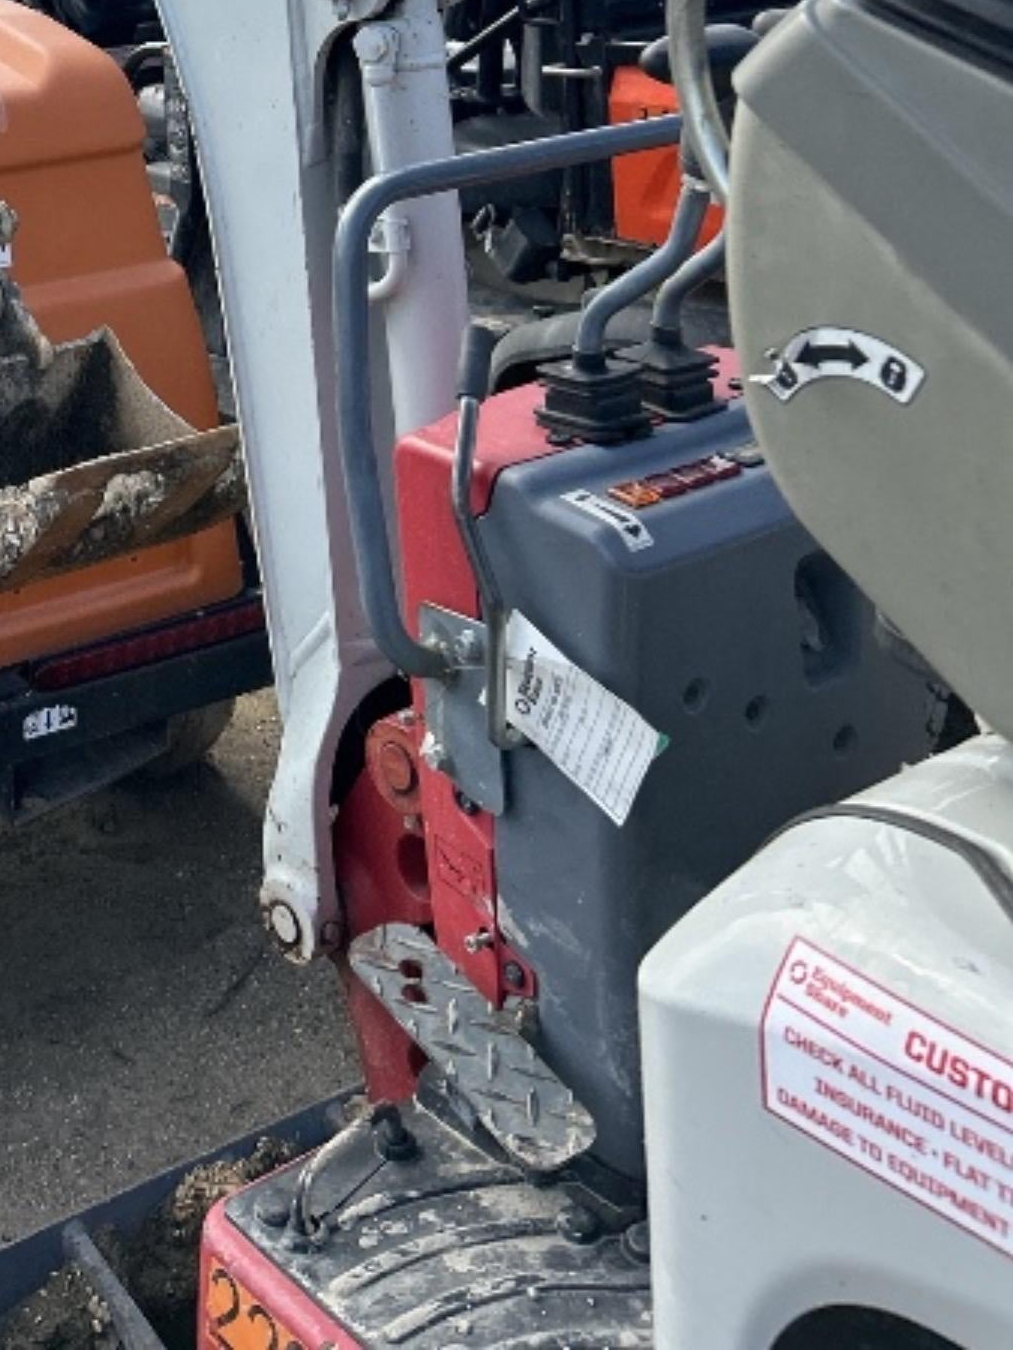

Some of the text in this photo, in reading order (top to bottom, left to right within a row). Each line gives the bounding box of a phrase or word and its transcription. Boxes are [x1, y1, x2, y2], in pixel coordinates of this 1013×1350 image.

[777, 1088, 1009, 1238] DAMAGE TO EQUIPMENT
[784, 1025, 1013, 1171] CHECK ALL FLUID LEVEL
[814, 1077, 928, 1156] INSURANCE
[942, 1151, 991, 1191] FLAT
